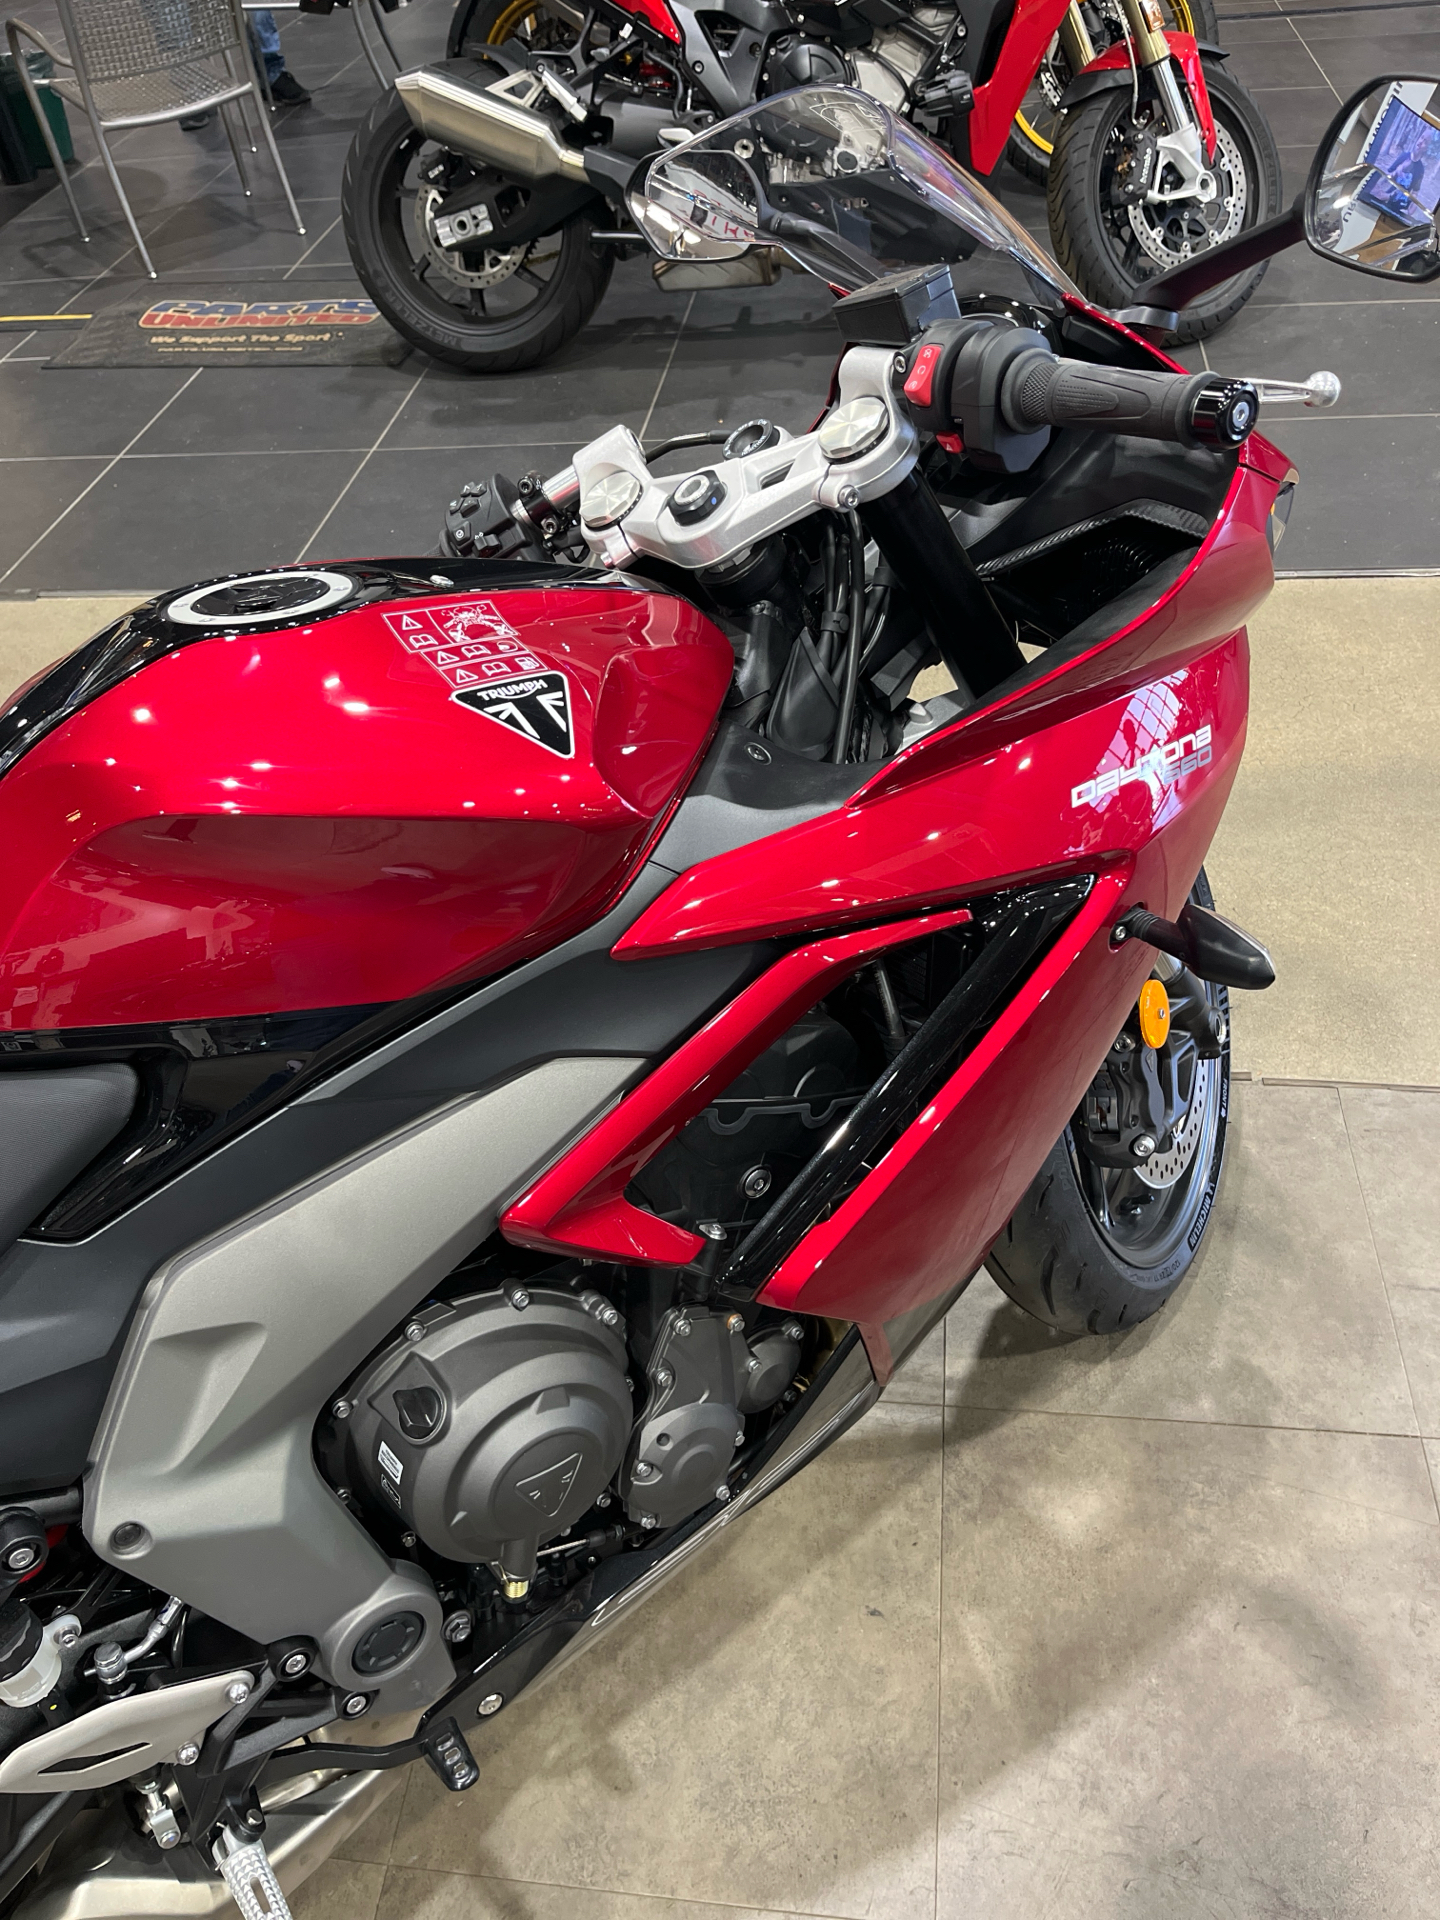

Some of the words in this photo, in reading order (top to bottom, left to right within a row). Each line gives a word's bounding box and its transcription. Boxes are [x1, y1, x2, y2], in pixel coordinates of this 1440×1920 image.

[1140, 147, 1152, 184] brembo
[149, 299, 381, 316] PARTS
[140, 312, 378, 328] UNLIMITED
[150, 335, 176, 344] We
[179, 334, 247, 345] Support
[250, 333, 280, 343] The
[283, 332, 331, 344] Sport
[477, 678, 548, 700] TRIUMPH
[1219, 1077, 1228, 1108] FRONT
[1189, 1195, 1211, 1247] MICHELIN
